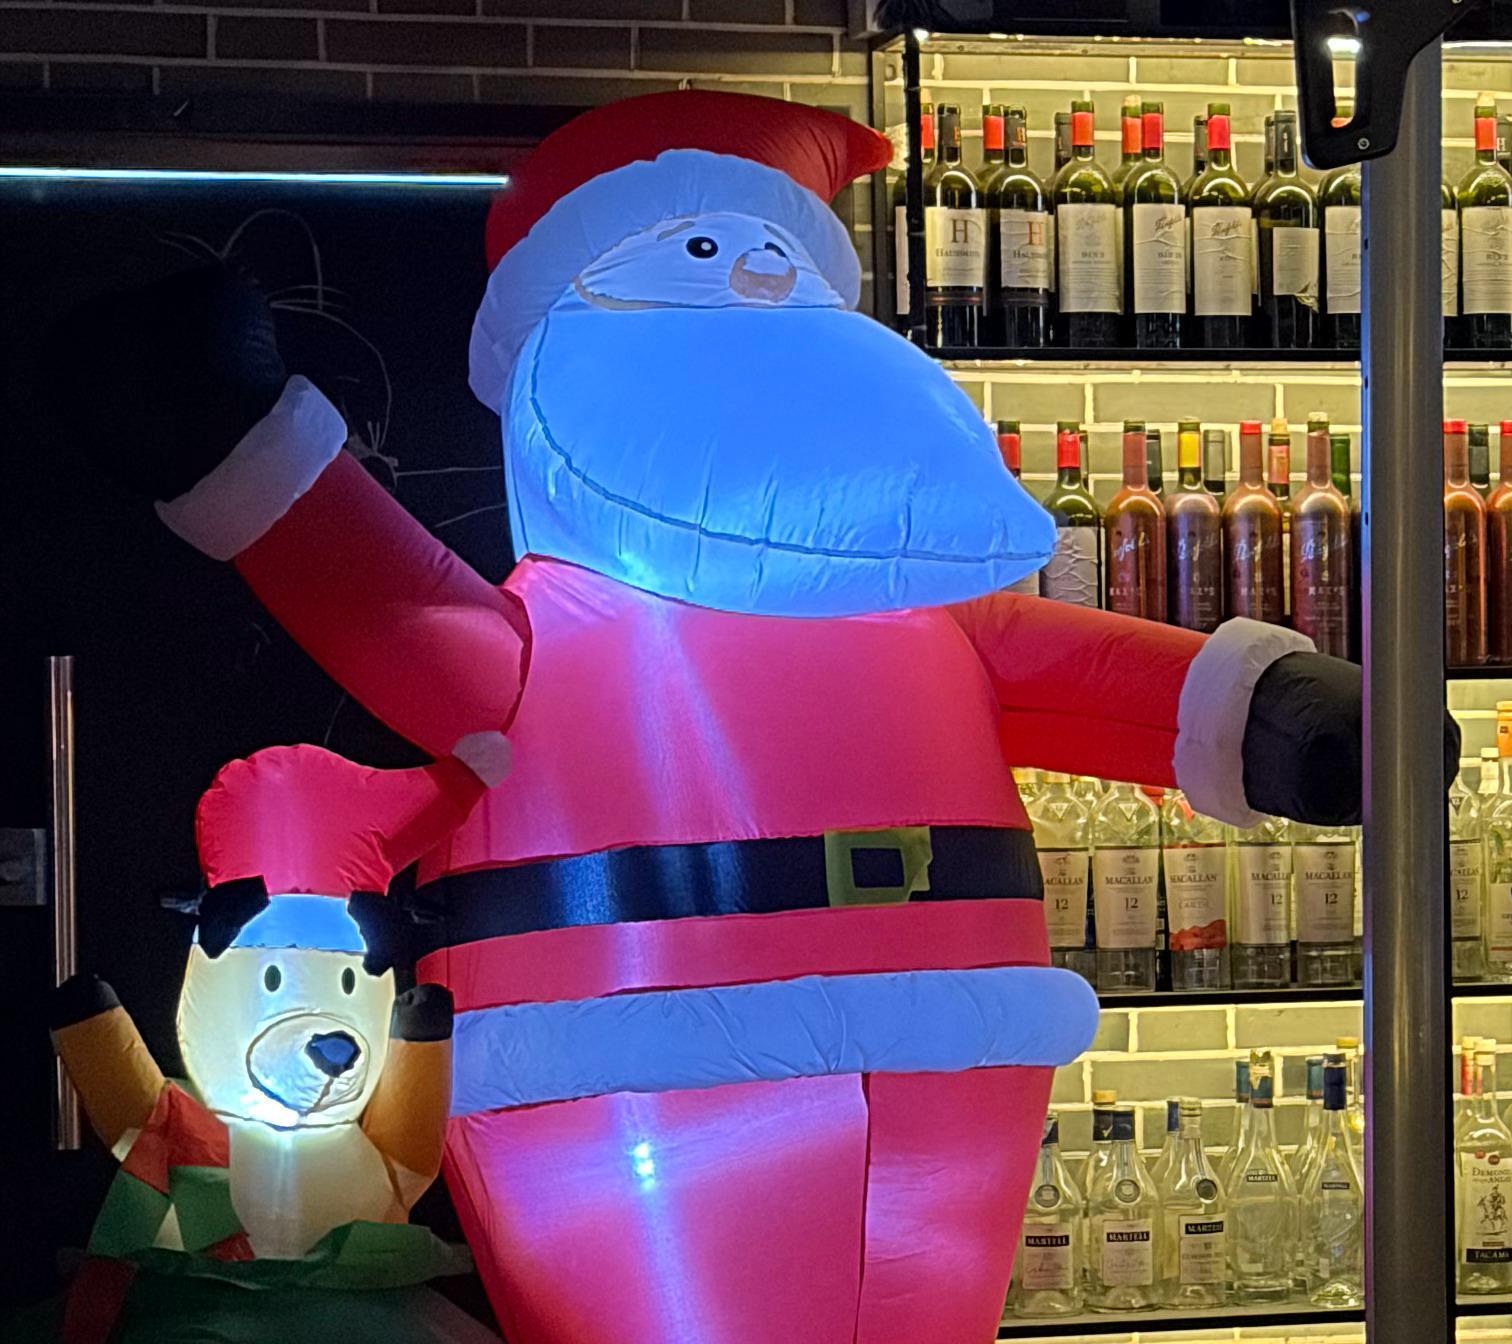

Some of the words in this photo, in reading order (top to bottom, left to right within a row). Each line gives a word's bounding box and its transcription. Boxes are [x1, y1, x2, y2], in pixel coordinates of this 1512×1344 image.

[952, 219, 968, 243] H
[1045, 876, 1084, 885] ACALLAN
[1105, 876, 1152, 885] MACALLAN
[1270, 893, 1283, 905] 12
[1324, 892, 1338, 905] 12
[1456, 889, 1469, 901] 12
[1055, 898, 1069, 910] 12
[1126, 897, 1139, 910] 12
